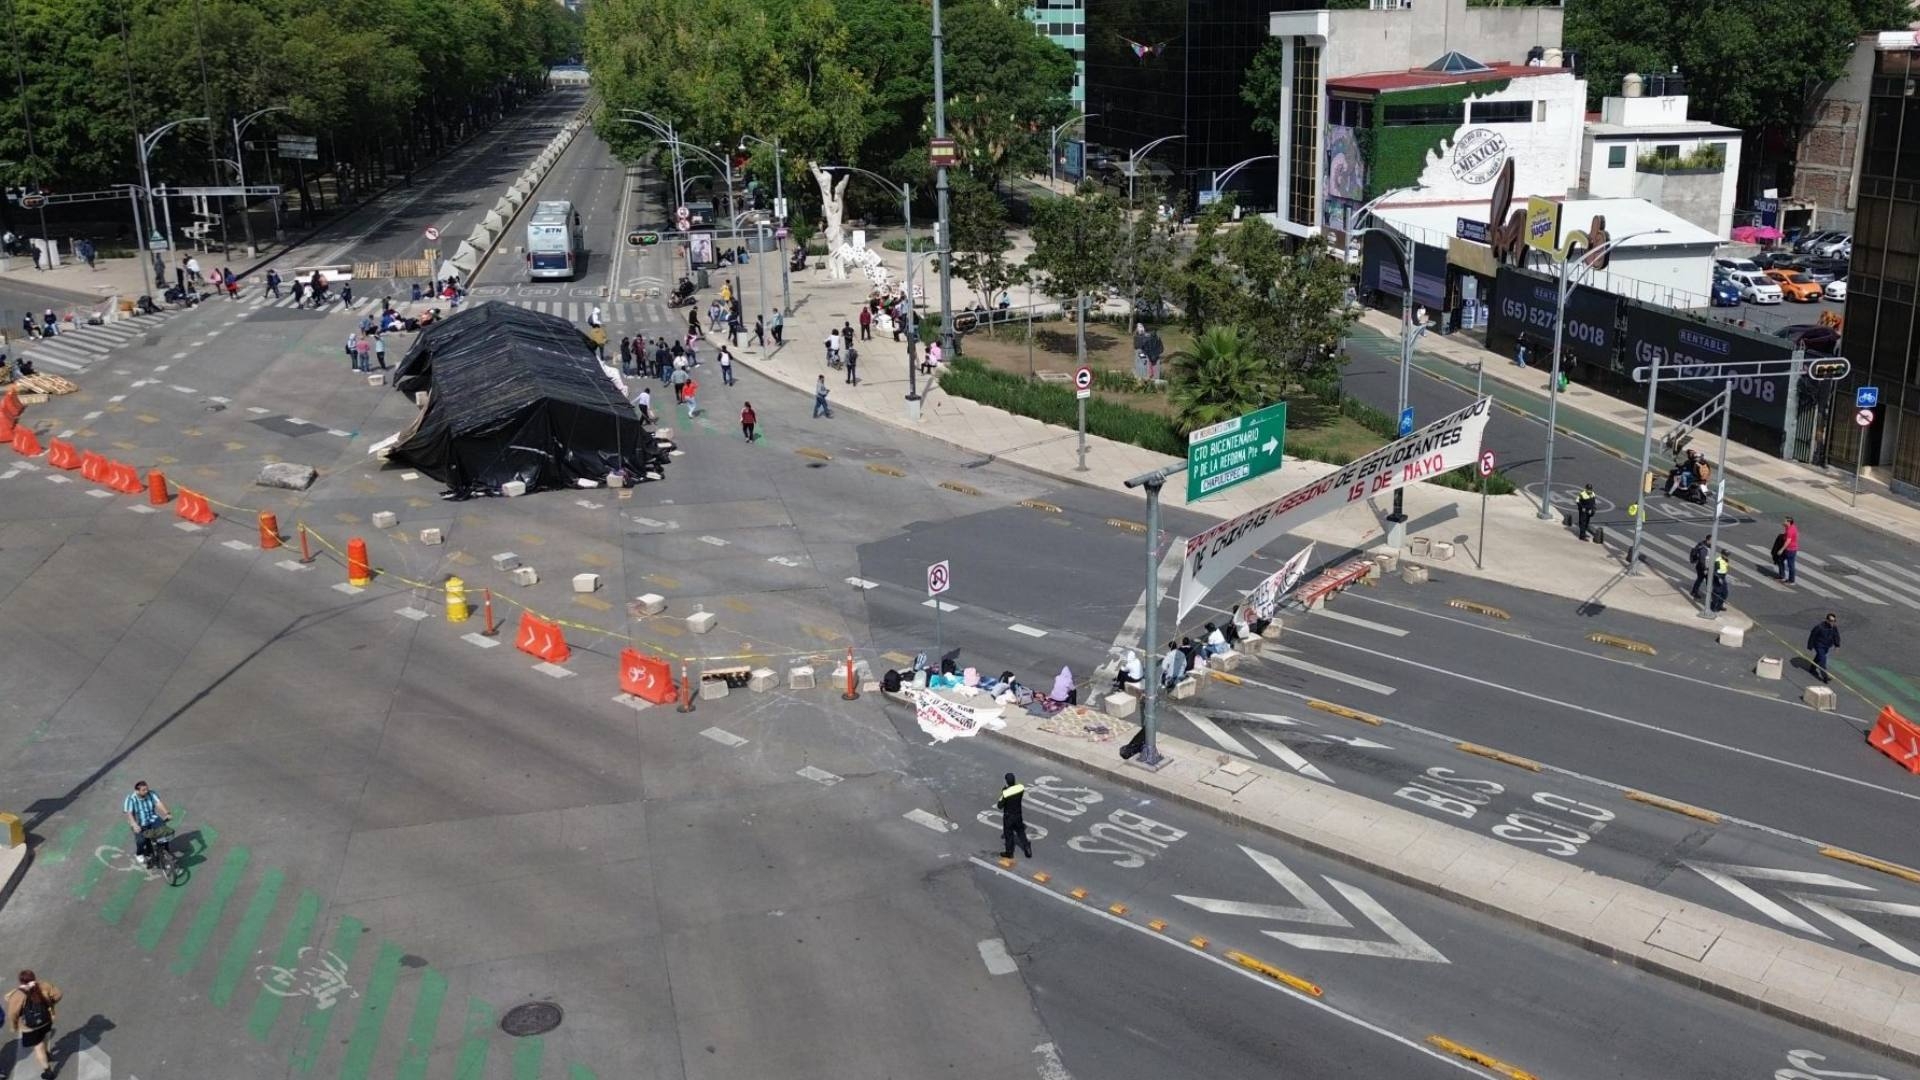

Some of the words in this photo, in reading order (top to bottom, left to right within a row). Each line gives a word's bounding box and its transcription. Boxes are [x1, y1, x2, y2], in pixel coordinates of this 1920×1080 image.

[1502, 297, 1527, 322] (55)
[1569, 320, 1604, 347] 0018
[1680, 331, 1728, 353] RENTABLE
[1193, 464, 1199, 479] P
[1200, 461, 1209, 477] DE
[1210, 458, 1218, 474] LA
[1219, 448, 1246, 470] REFORMA
[1194, 444, 1208, 462] CTO
[1210, 427, 1259, 456] BICENTENARIO
[1211, 509, 1272, 557] CHIAPAS
[1334, 467, 1356, 489] DE
[1358, 426, 1463, 480] ESTUDIANTES
[1347, 481, 1365, 502] 15
[1371, 470, 1393, 493] DE
[1403, 453, 1443, 482] MAYO
[1393, 766, 1505, 819] BUS
[1067, 808, 1189, 868] BUS
